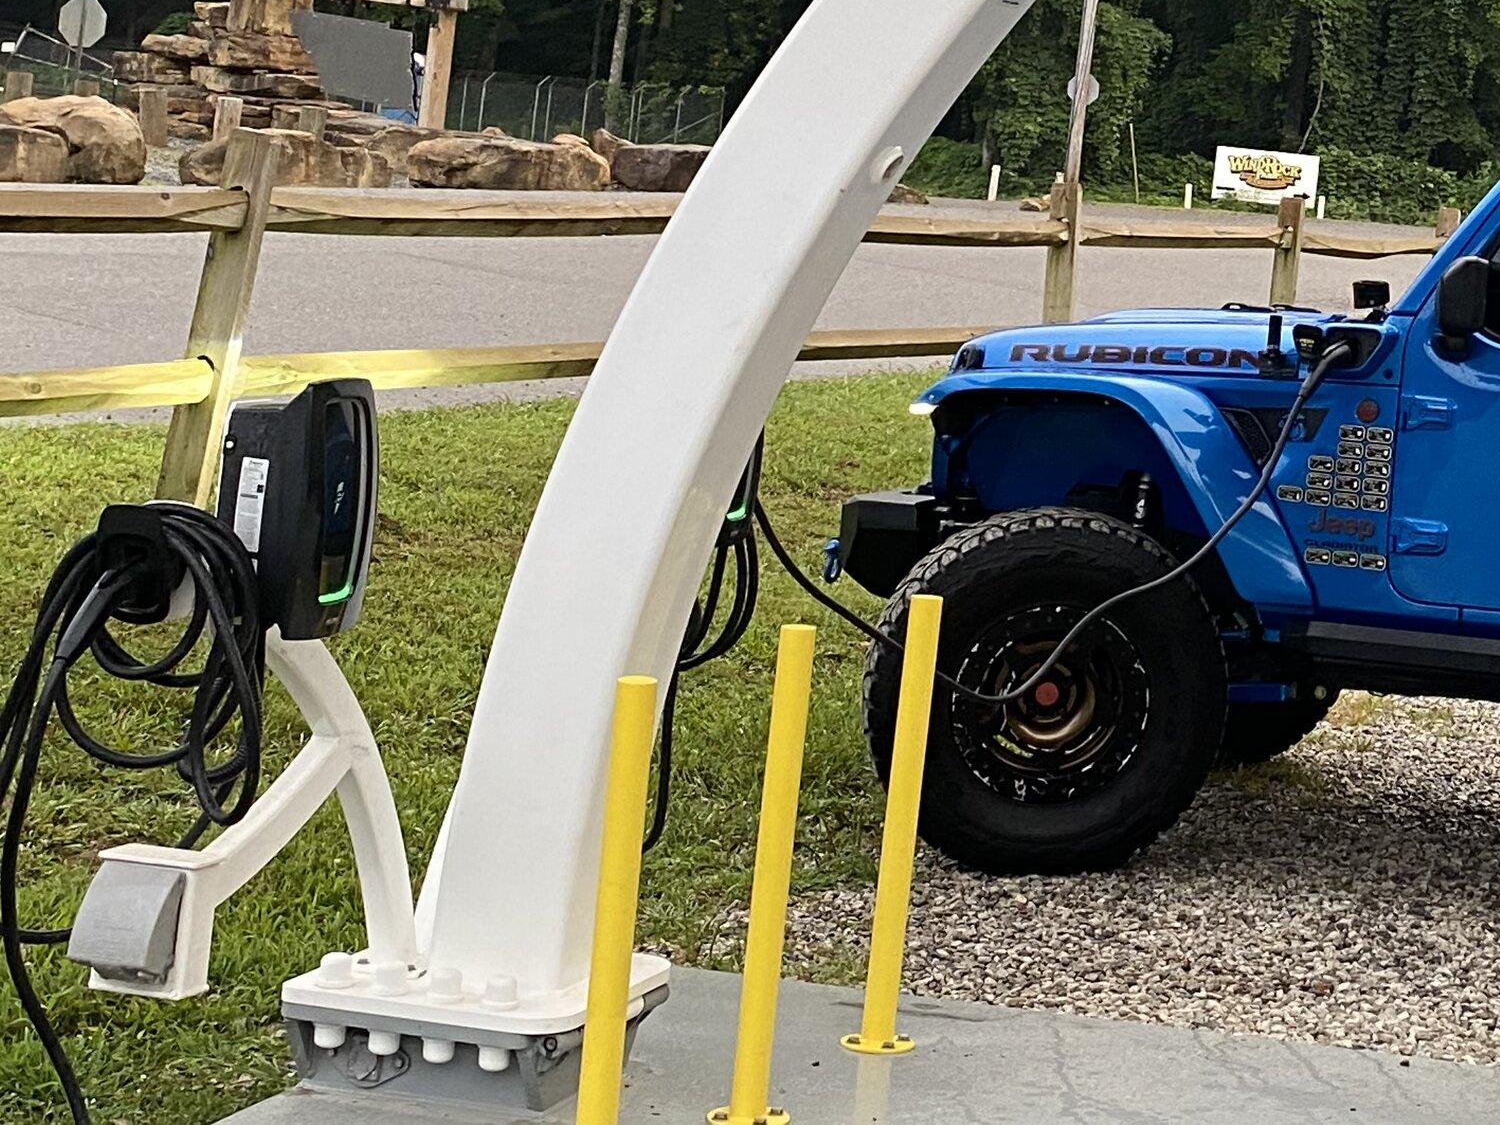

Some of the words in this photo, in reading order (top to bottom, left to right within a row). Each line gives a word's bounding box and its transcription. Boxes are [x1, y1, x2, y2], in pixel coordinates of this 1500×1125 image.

[1009, 344, 1263, 369] RUBICON
[1307, 509, 1375, 541] Jeep
[1304, 538, 1379, 552] GLADIATOR
